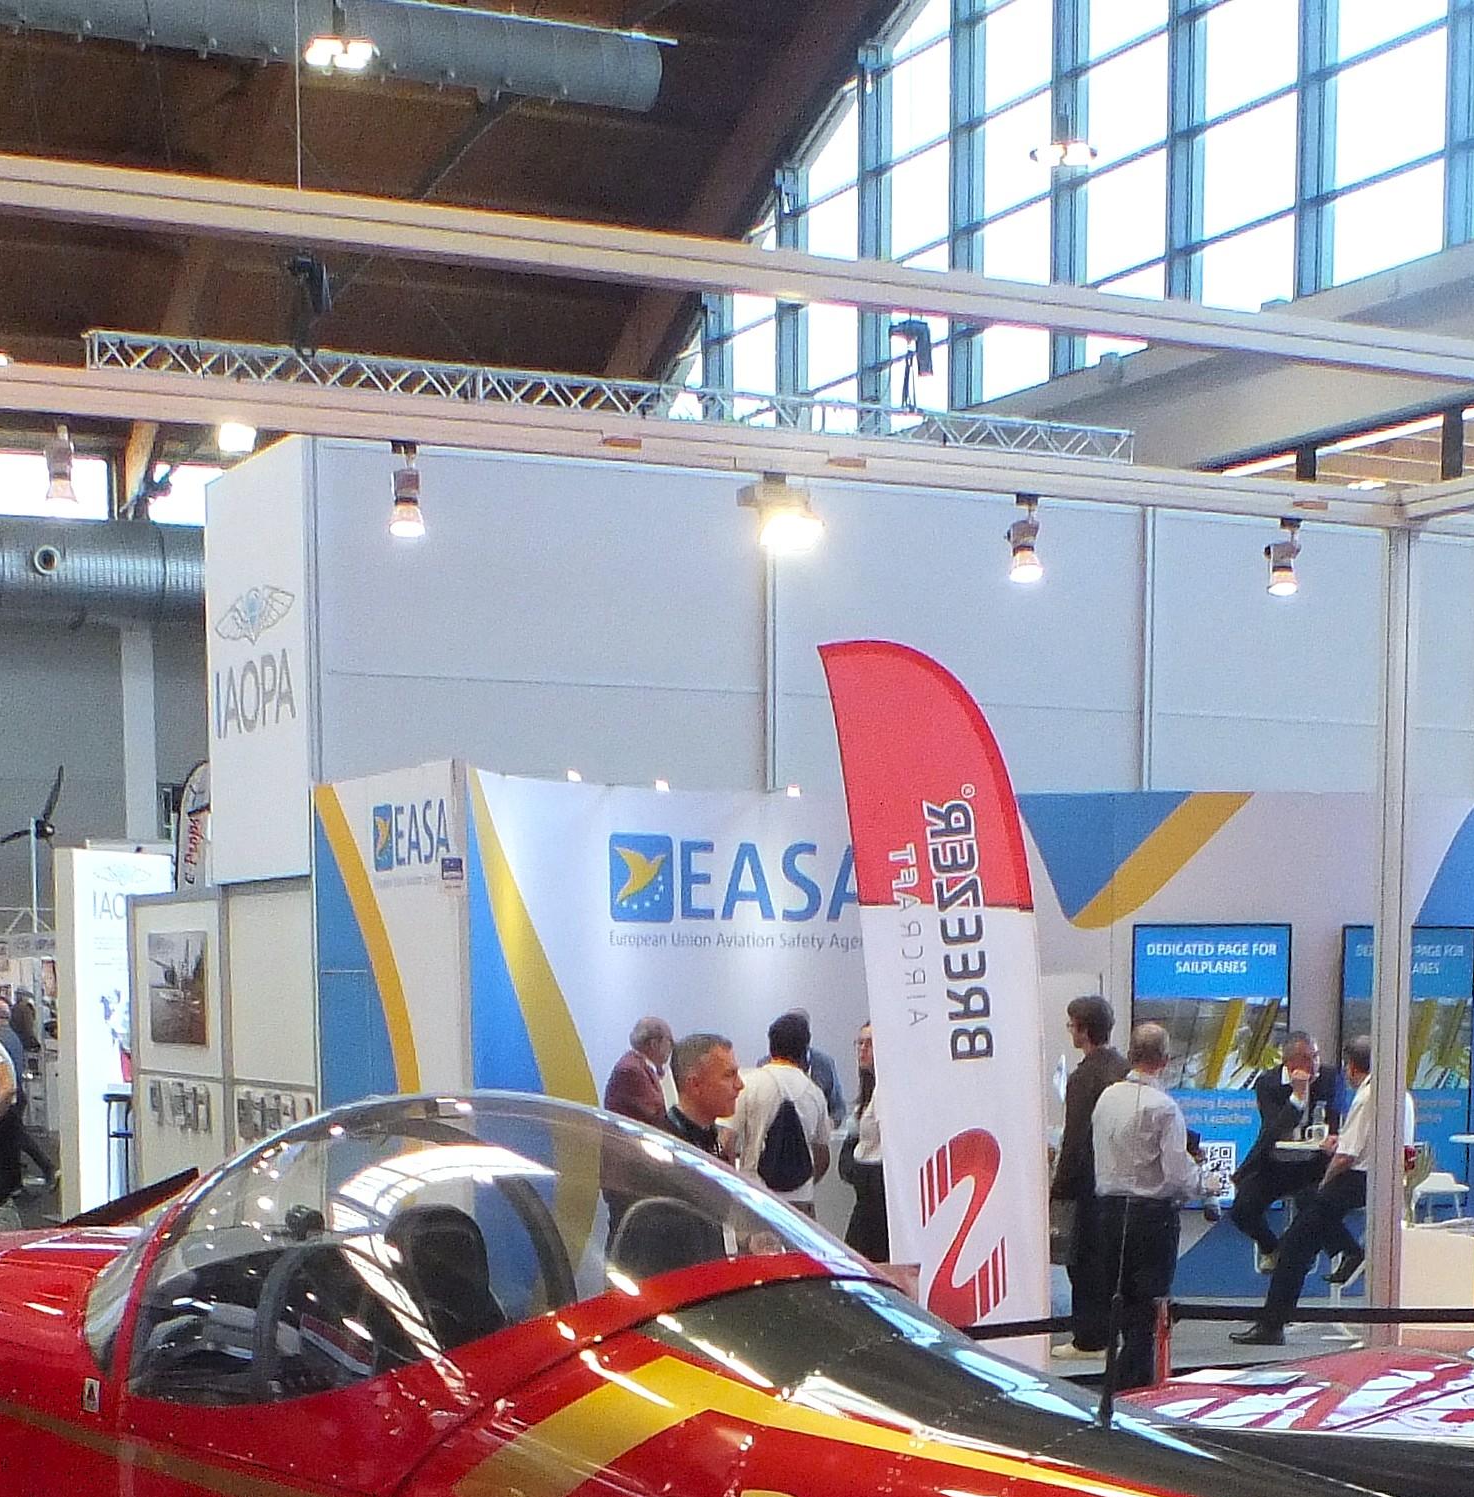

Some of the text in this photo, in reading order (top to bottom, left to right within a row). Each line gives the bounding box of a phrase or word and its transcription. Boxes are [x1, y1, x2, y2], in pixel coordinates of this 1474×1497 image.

[215, 648, 296, 739] IAOPA
[394, 798, 450, 866] EASA
[93, 890, 127, 921] IAO
[609, 931, 666, 949] European
[671, 932, 711, 948] Union
[716, 932, 773, 949] Aviation
[780, 931, 823, 951] Safety
[1147, 944, 1277, 957] DEDICATED PAGE FOR
[1175, 960, 1247, 974] SAILPLANES
